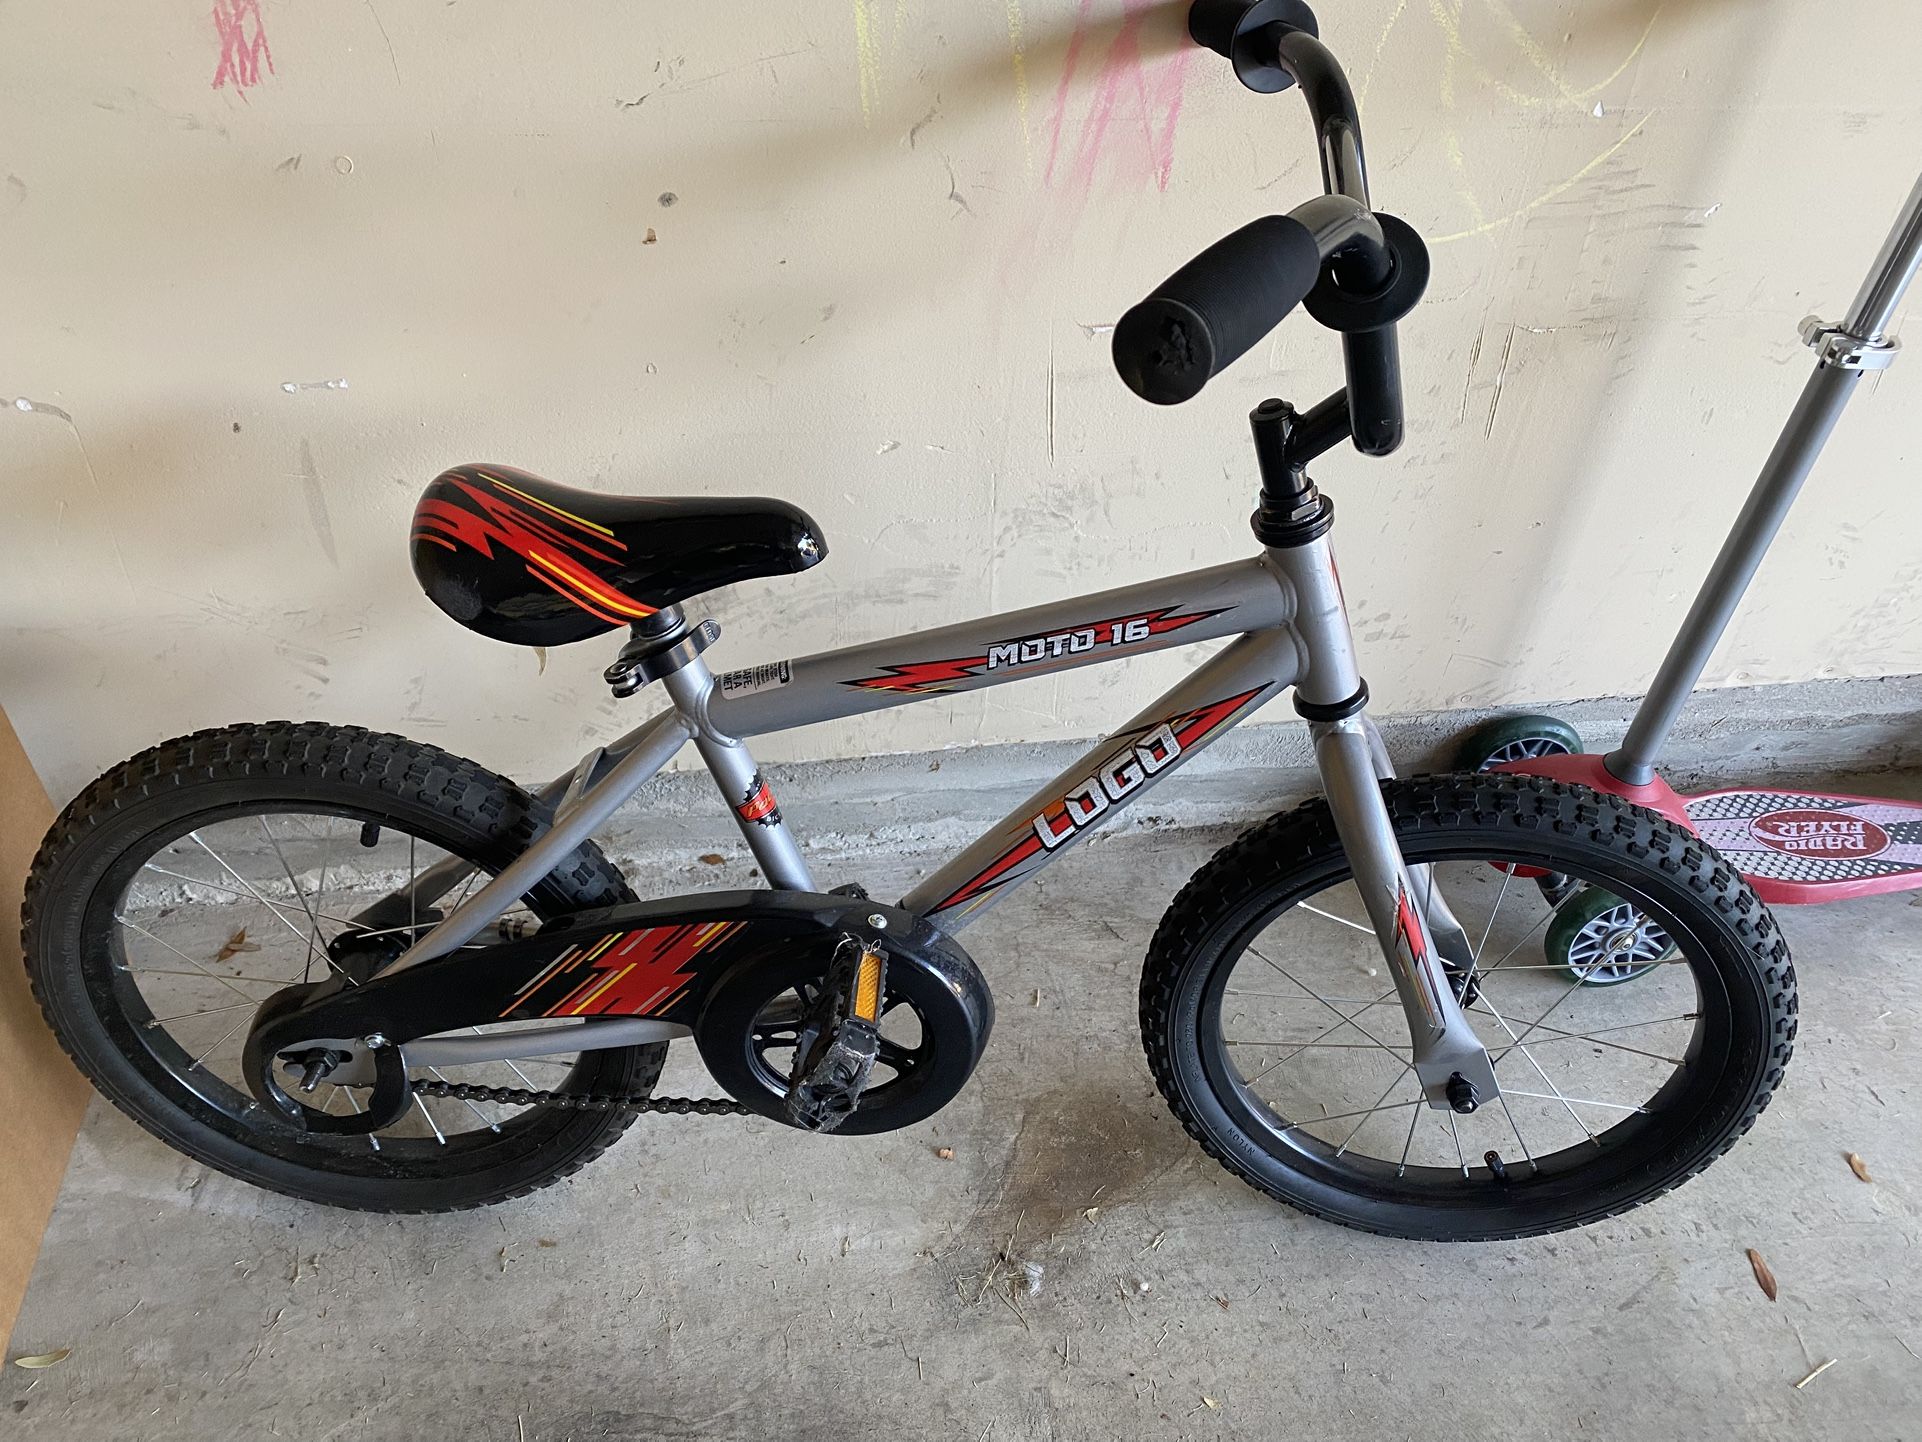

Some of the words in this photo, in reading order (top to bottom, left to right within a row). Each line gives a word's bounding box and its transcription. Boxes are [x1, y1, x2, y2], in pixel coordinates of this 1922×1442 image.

[987, 628, 1096, 670] MOTO
[1111, 618, 1151, 646] 16
[1031, 722, 1183, 851] LOGO
[1772, 821, 1866, 837] FLYER
[1784, 834, 1868, 850] RADIO
[1227, 1127, 1256, 1156] NYLON
